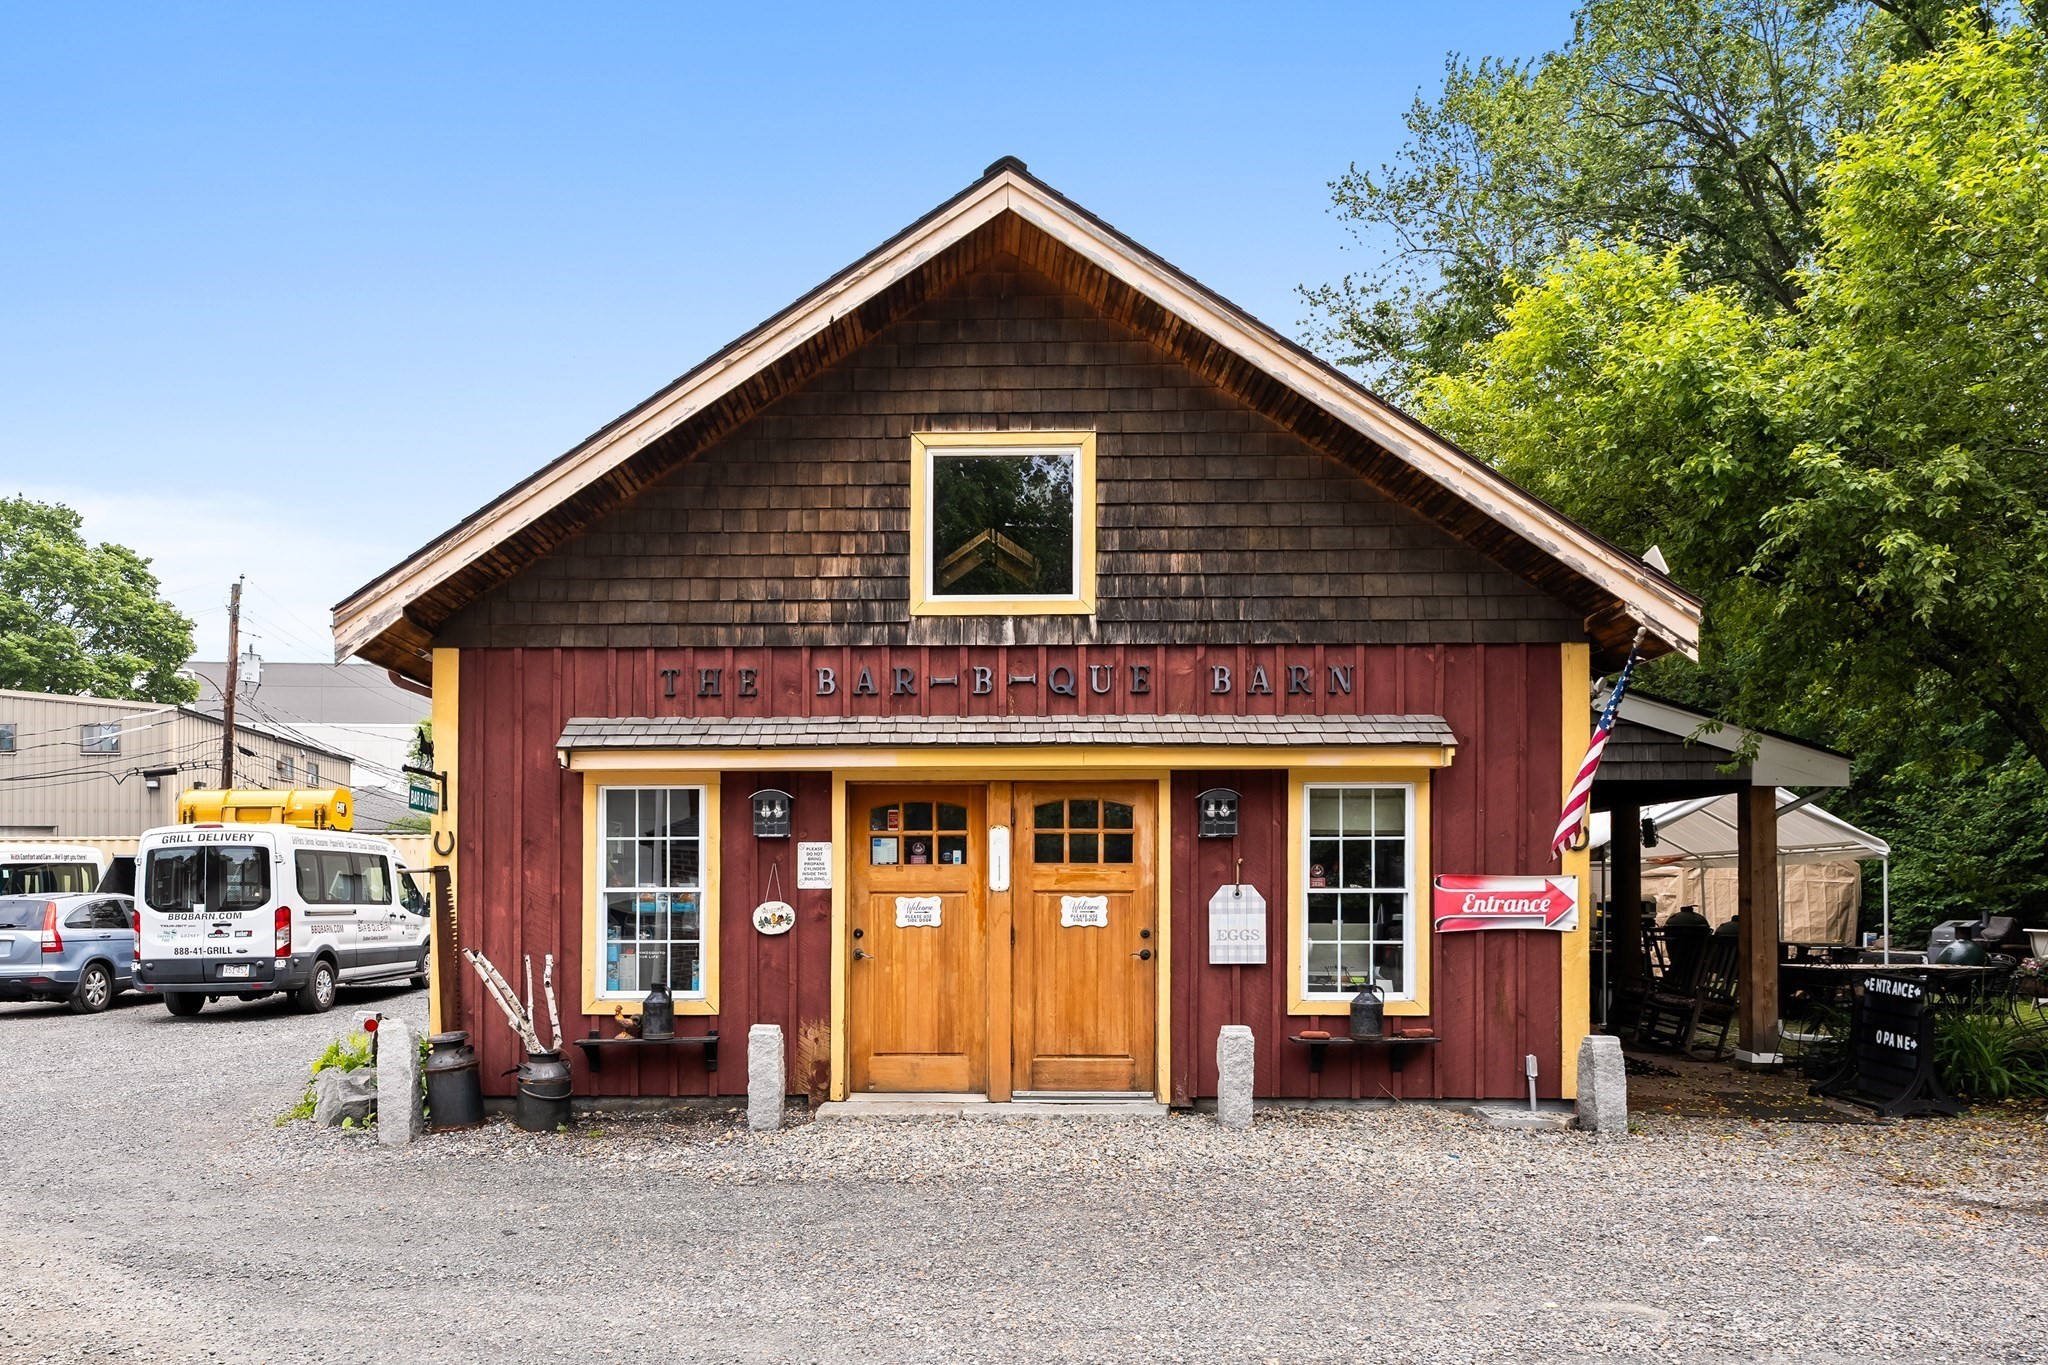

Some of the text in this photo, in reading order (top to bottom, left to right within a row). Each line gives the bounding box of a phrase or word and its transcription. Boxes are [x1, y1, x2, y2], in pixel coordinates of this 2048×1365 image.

[660, 667, 758, 697] THE
[1210, 664, 1354, 695] BARN
[336, 801, 346, 813] CAT
[161, 833, 255, 844] GRILL DELIVERY
[904, 901, 933, 914] Welcome
[1069, 900, 1100, 913] Welcome
[1462, 893, 1552, 913] Entrance
[168, 912, 243, 921] BBQBARN.COM
[310, 925, 344, 934] BBQBARN.COM
[1215, 928, 1261, 941] EGGS
[174, 946, 233, 955] 888-41-GRILL
[1869, 977, 1915, 998] ENTRANCE
